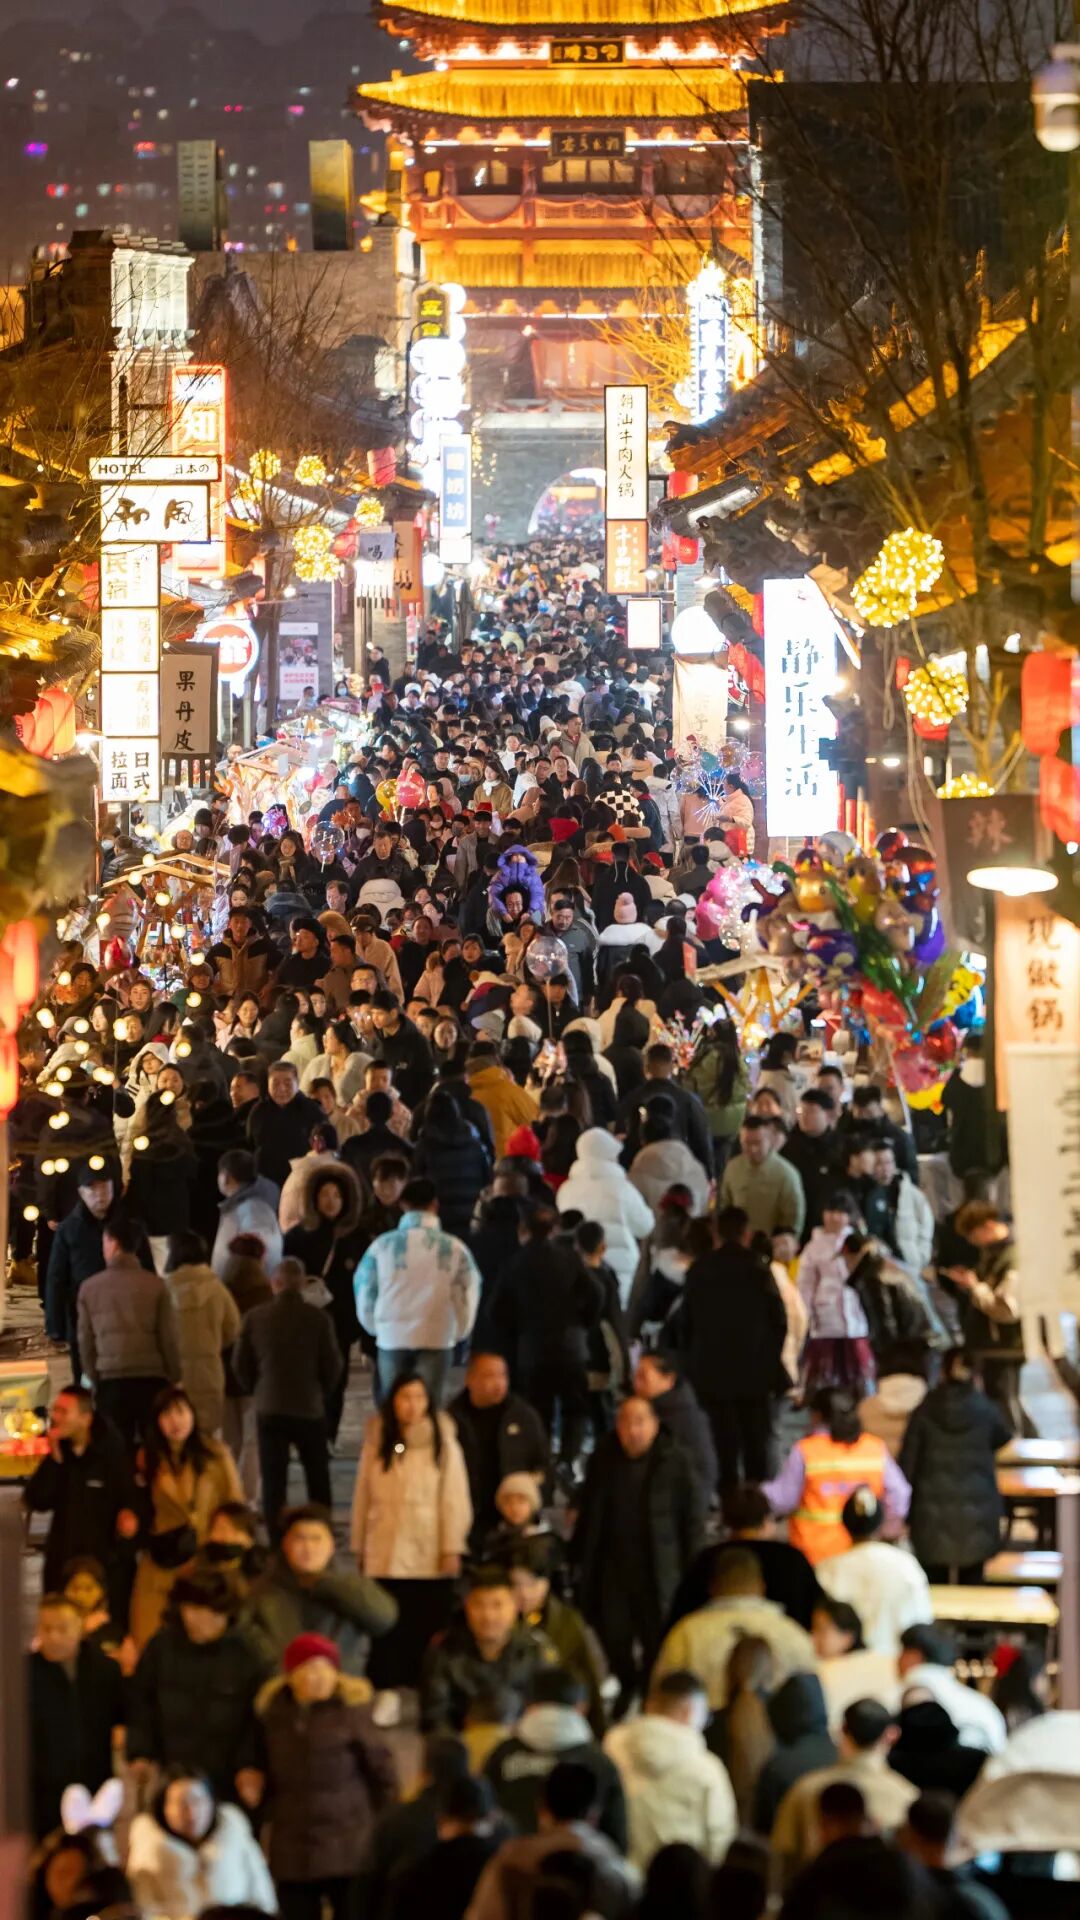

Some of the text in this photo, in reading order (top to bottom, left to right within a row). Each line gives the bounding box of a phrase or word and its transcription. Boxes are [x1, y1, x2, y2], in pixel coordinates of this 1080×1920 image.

[98, 463, 210, 475] HOTEL 日本の
[106, 553, 128, 600] 民宿
[174, 670, 195, 752] 果丹皮
[111, 751, 128, 790] 拉面
[133, 751, 150, 790] 日式
[1027, 915, 1064, 1043] 现做锅
